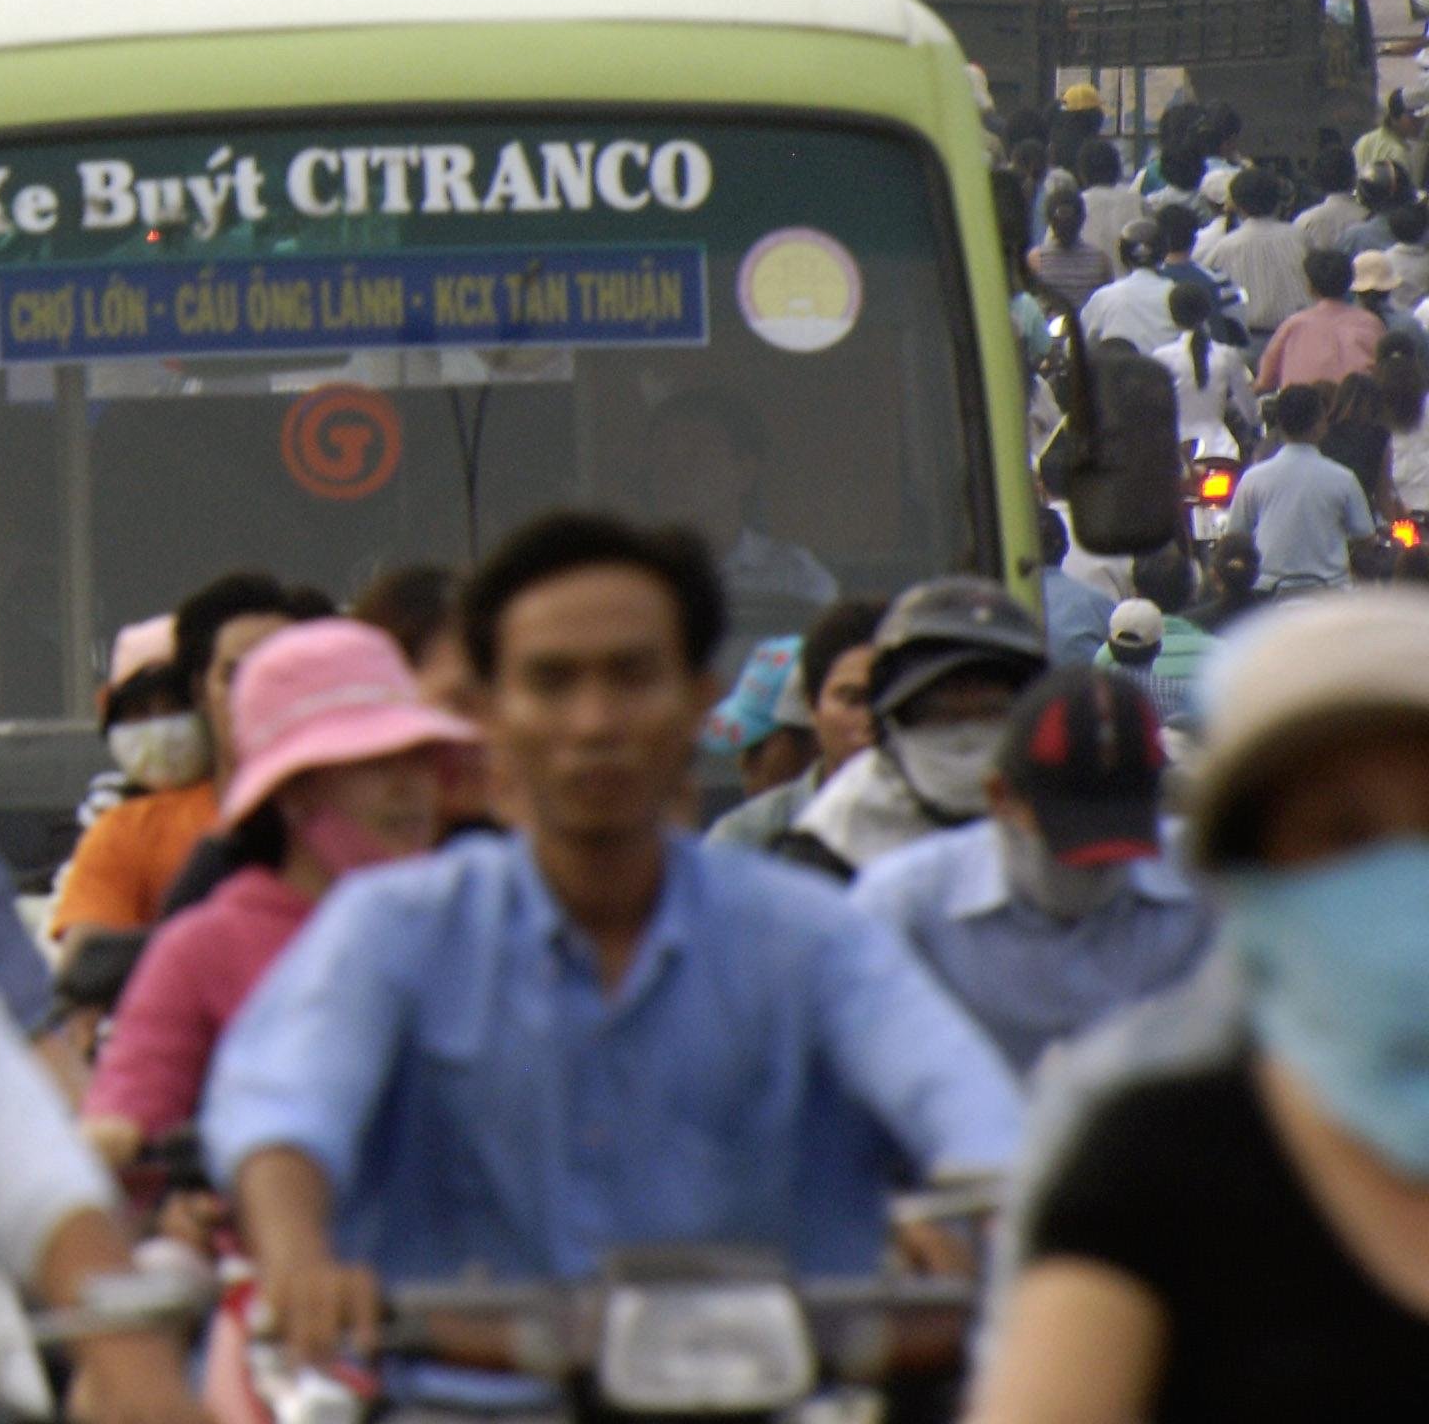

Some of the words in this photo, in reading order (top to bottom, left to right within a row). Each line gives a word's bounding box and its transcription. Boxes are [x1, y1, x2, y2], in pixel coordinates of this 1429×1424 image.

[77, 144, 269, 241] Buýt
[286, 139, 712, 218] CITRANCO
[9, 283, 76, 349] CHỢ
[246, 265, 312, 333] ÔNG
[433, 273, 499, 327] KCX
[574, 258, 683, 333] THUẬN
